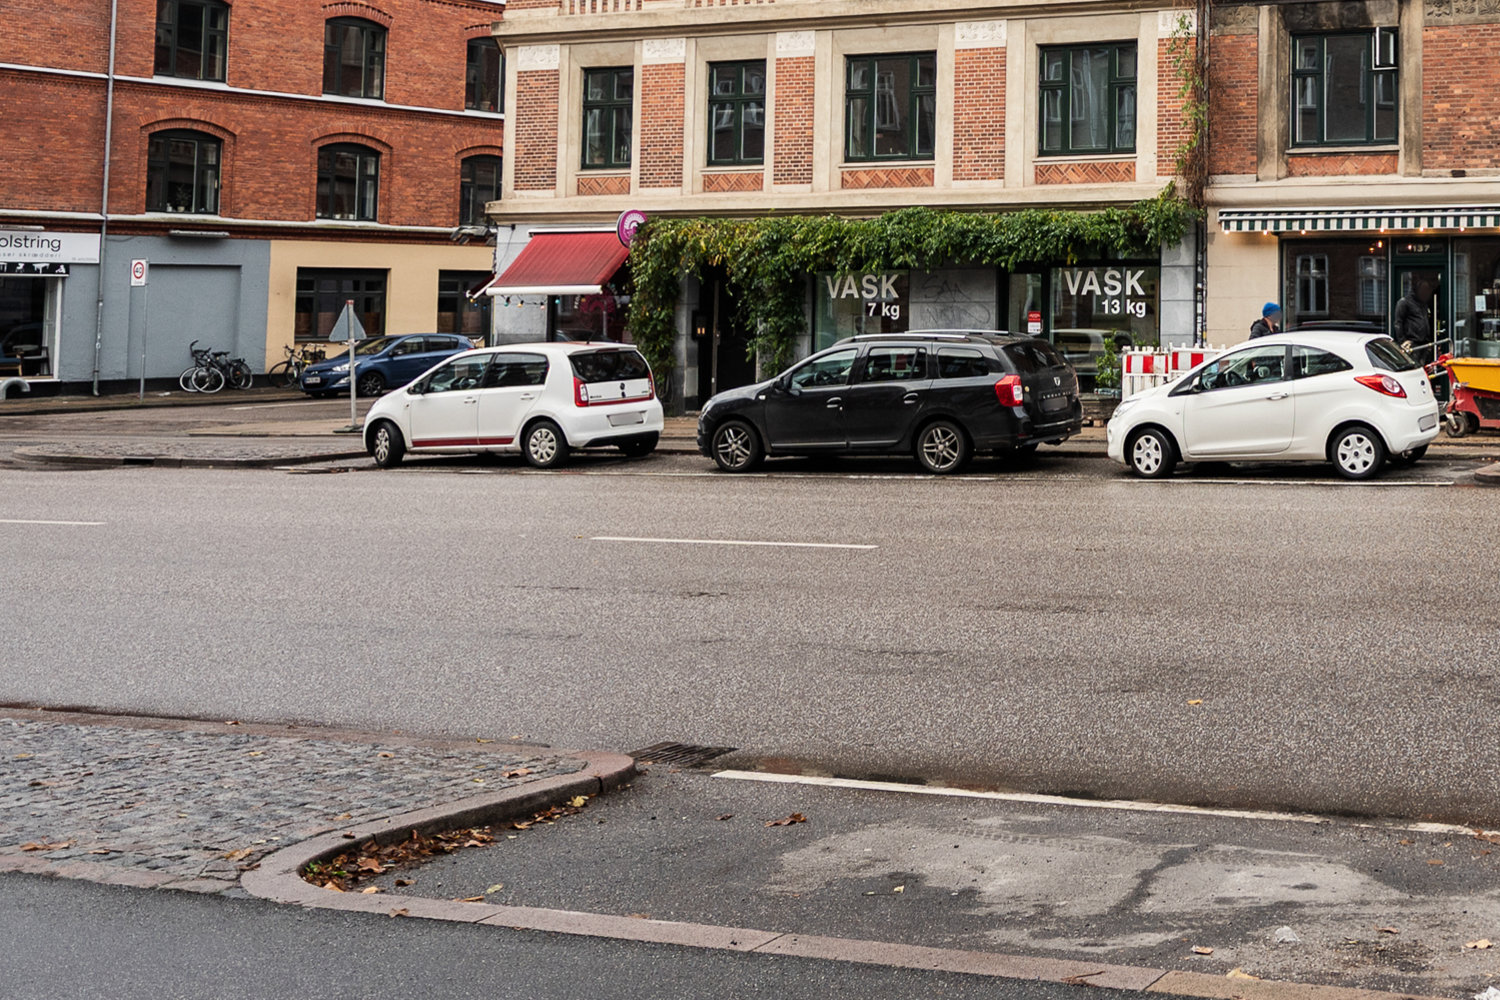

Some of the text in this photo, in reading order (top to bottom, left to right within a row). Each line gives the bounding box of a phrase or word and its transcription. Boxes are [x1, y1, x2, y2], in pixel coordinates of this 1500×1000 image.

[1413, 244, 1430, 252] 137
[826, 274, 899, 299] VASK
[1064, 270, 1146, 296] VASK
[867, 303, 900, 320] 7 kg
[1101, 299, 1146, 318] 13 kg
